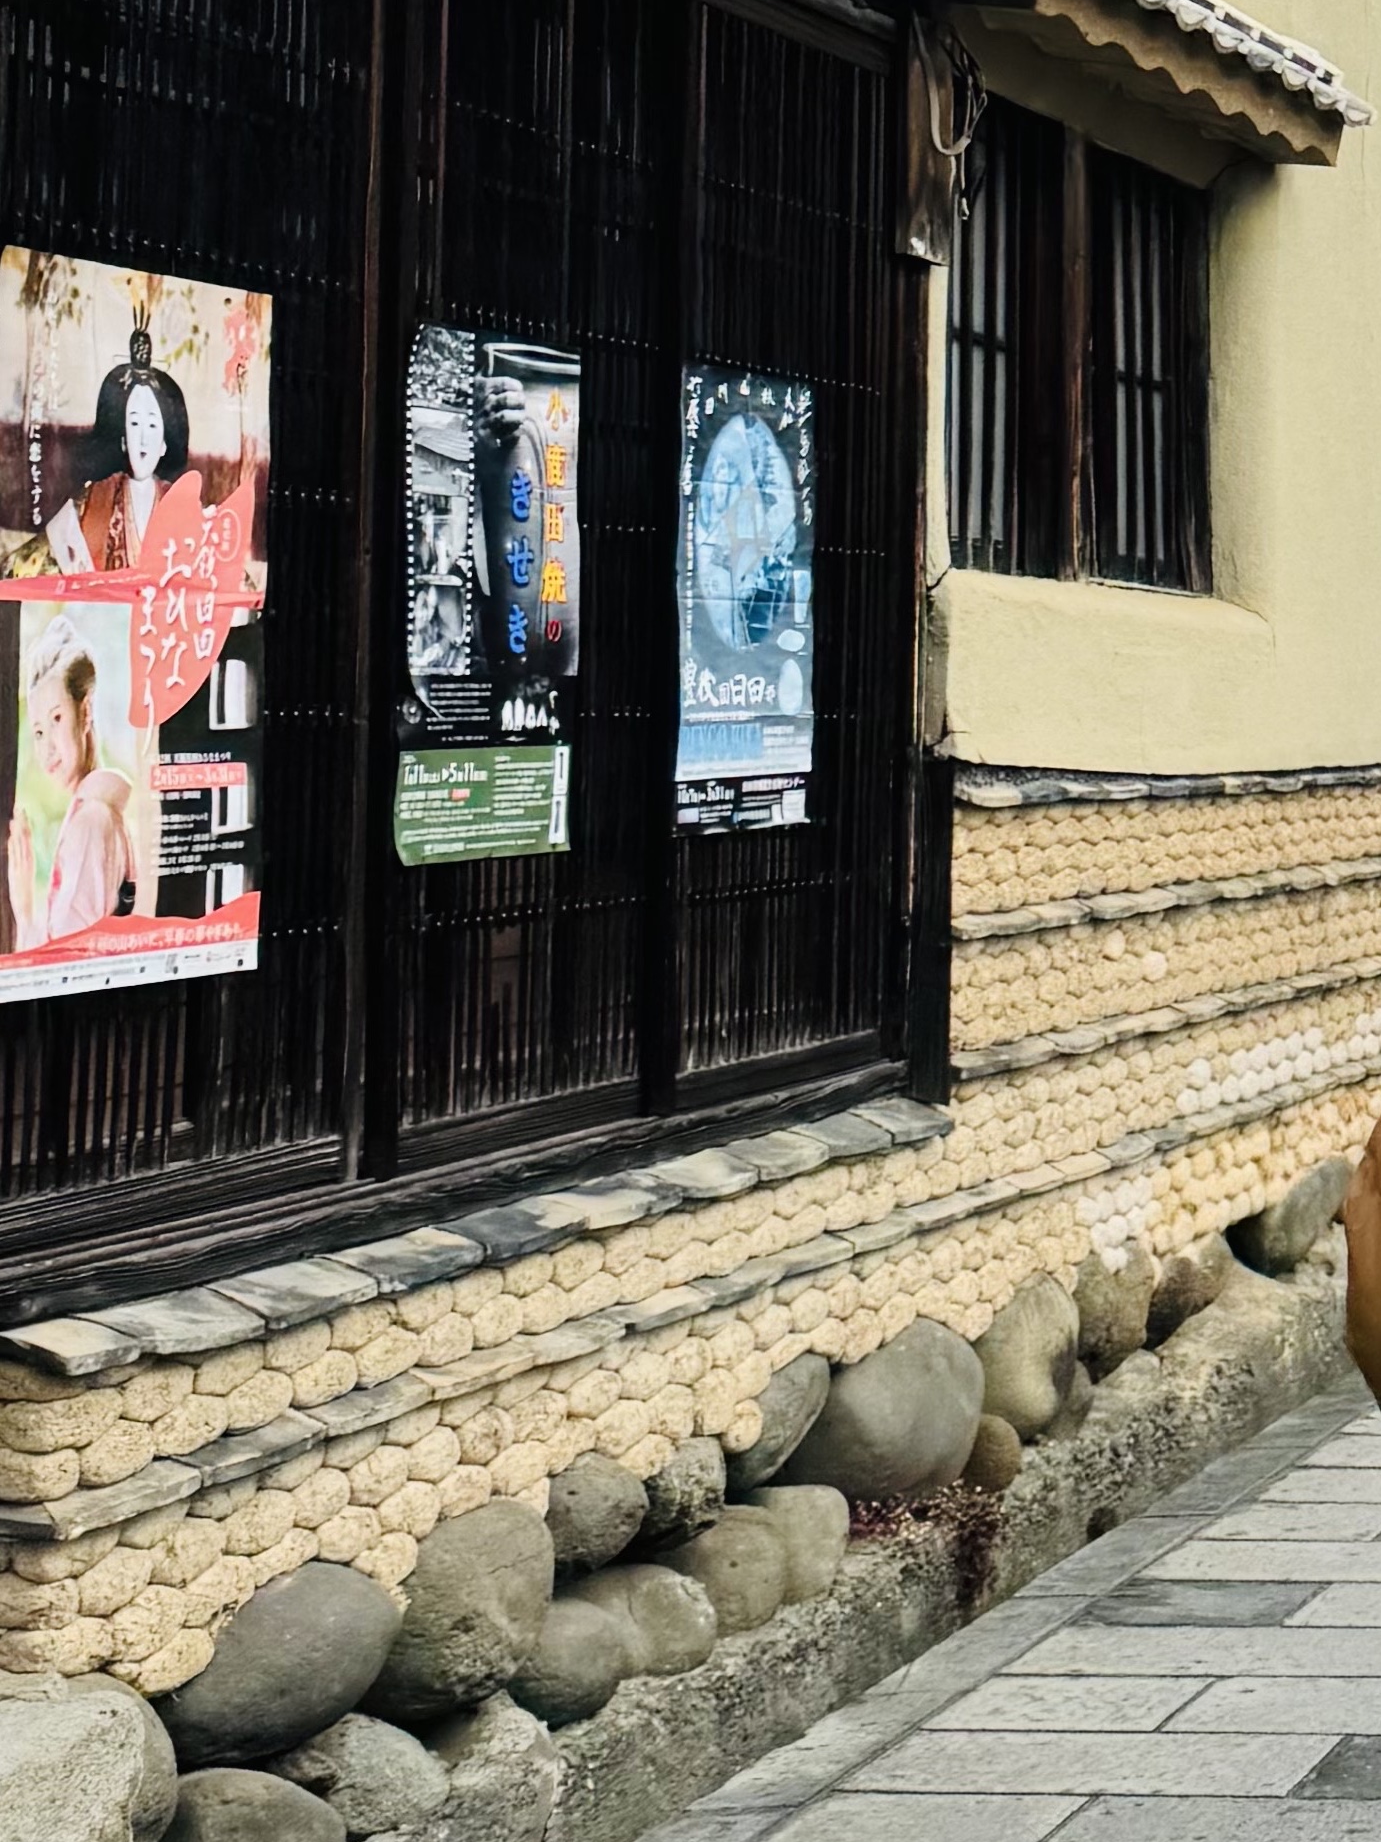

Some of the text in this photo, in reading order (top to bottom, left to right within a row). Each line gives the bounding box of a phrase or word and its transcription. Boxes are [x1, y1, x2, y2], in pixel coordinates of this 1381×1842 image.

[507, 467, 534, 655] きせき
[541, 388, 570, 643] 小鹿田焼の
[139, 584, 160, 759] まつり
